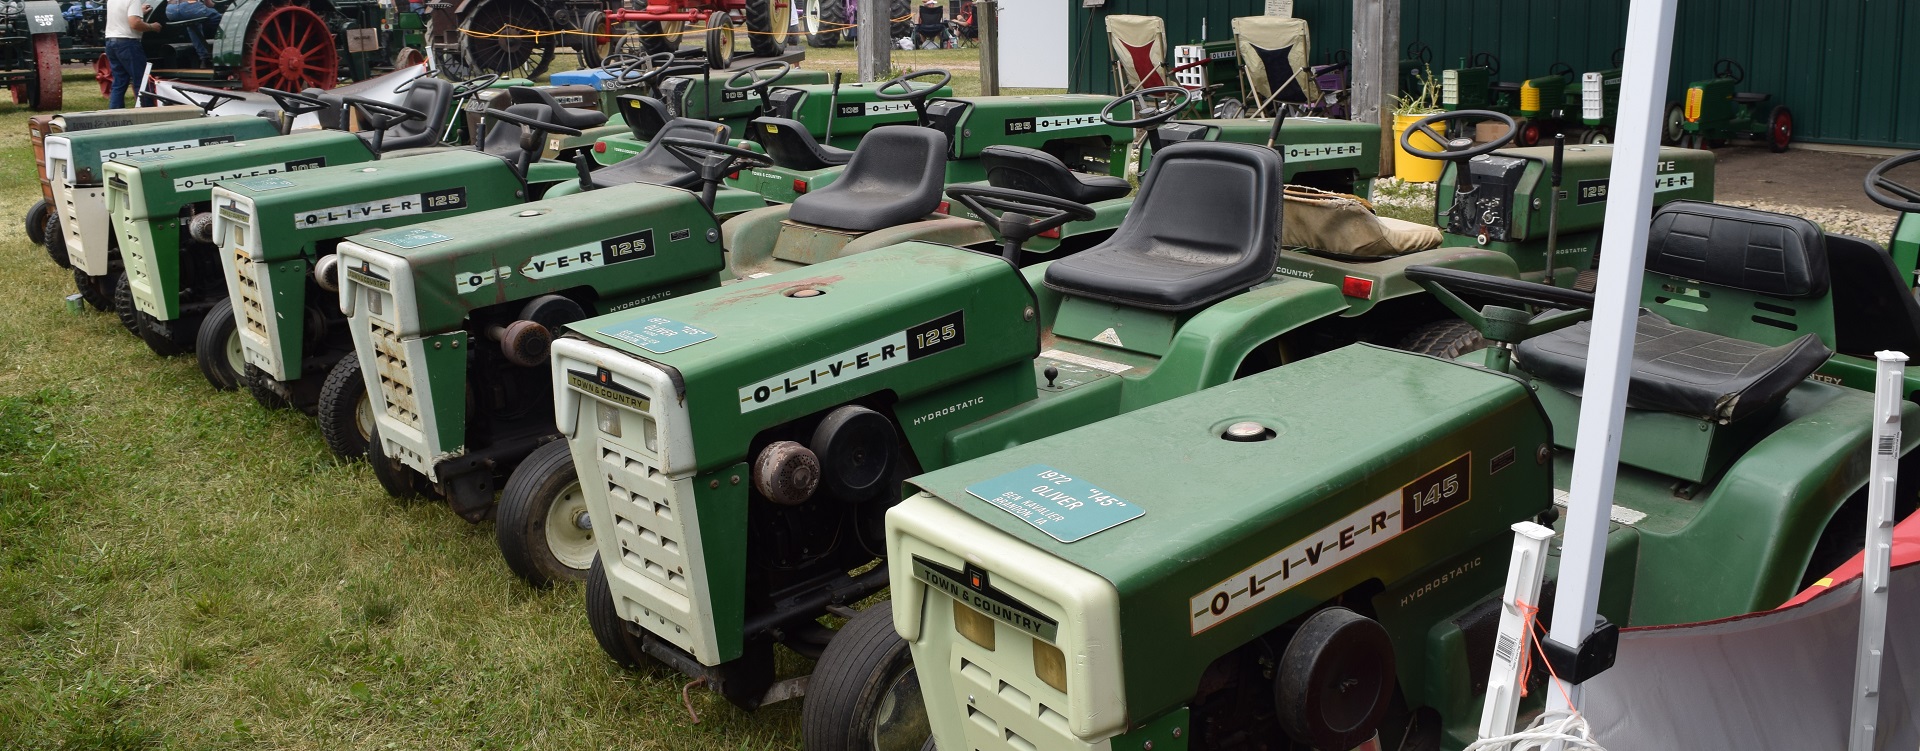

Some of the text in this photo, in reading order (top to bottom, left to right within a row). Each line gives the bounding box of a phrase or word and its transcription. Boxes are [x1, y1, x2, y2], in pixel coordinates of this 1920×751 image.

[872, 103, 910, 112] OLIV
[1009, 116, 1104, 131] 125 OLIVE
[1290, 145, 1356, 157] OLIVER
[1582, 185, 1607, 198] 125
[305, 193, 460, 225] OLIVER 125
[610, 238, 647, 257] 125
[1542, 247, 1588, 257] HROSTATIC
[1275, 266, 1314, 279] COUNTRY
[610, 290, 672, 312] HYDROSTATIC
[753, 323, 956, 403] OLIVER 125
[572, 377, 643, 408] TOWN & COUNTRY
[913, 396, 985, 426] HYDROSTATIC
[1036, 469, 1073, 485] 1972
[1031, 485, 1084, 510] OLIVER
[1209, 474, 1460, 617] OLIVER 145
[1400, 557, 1482, 607] HYDROSTATIC
[924, 569, 1042, 633] TOWN & COUNTRY
